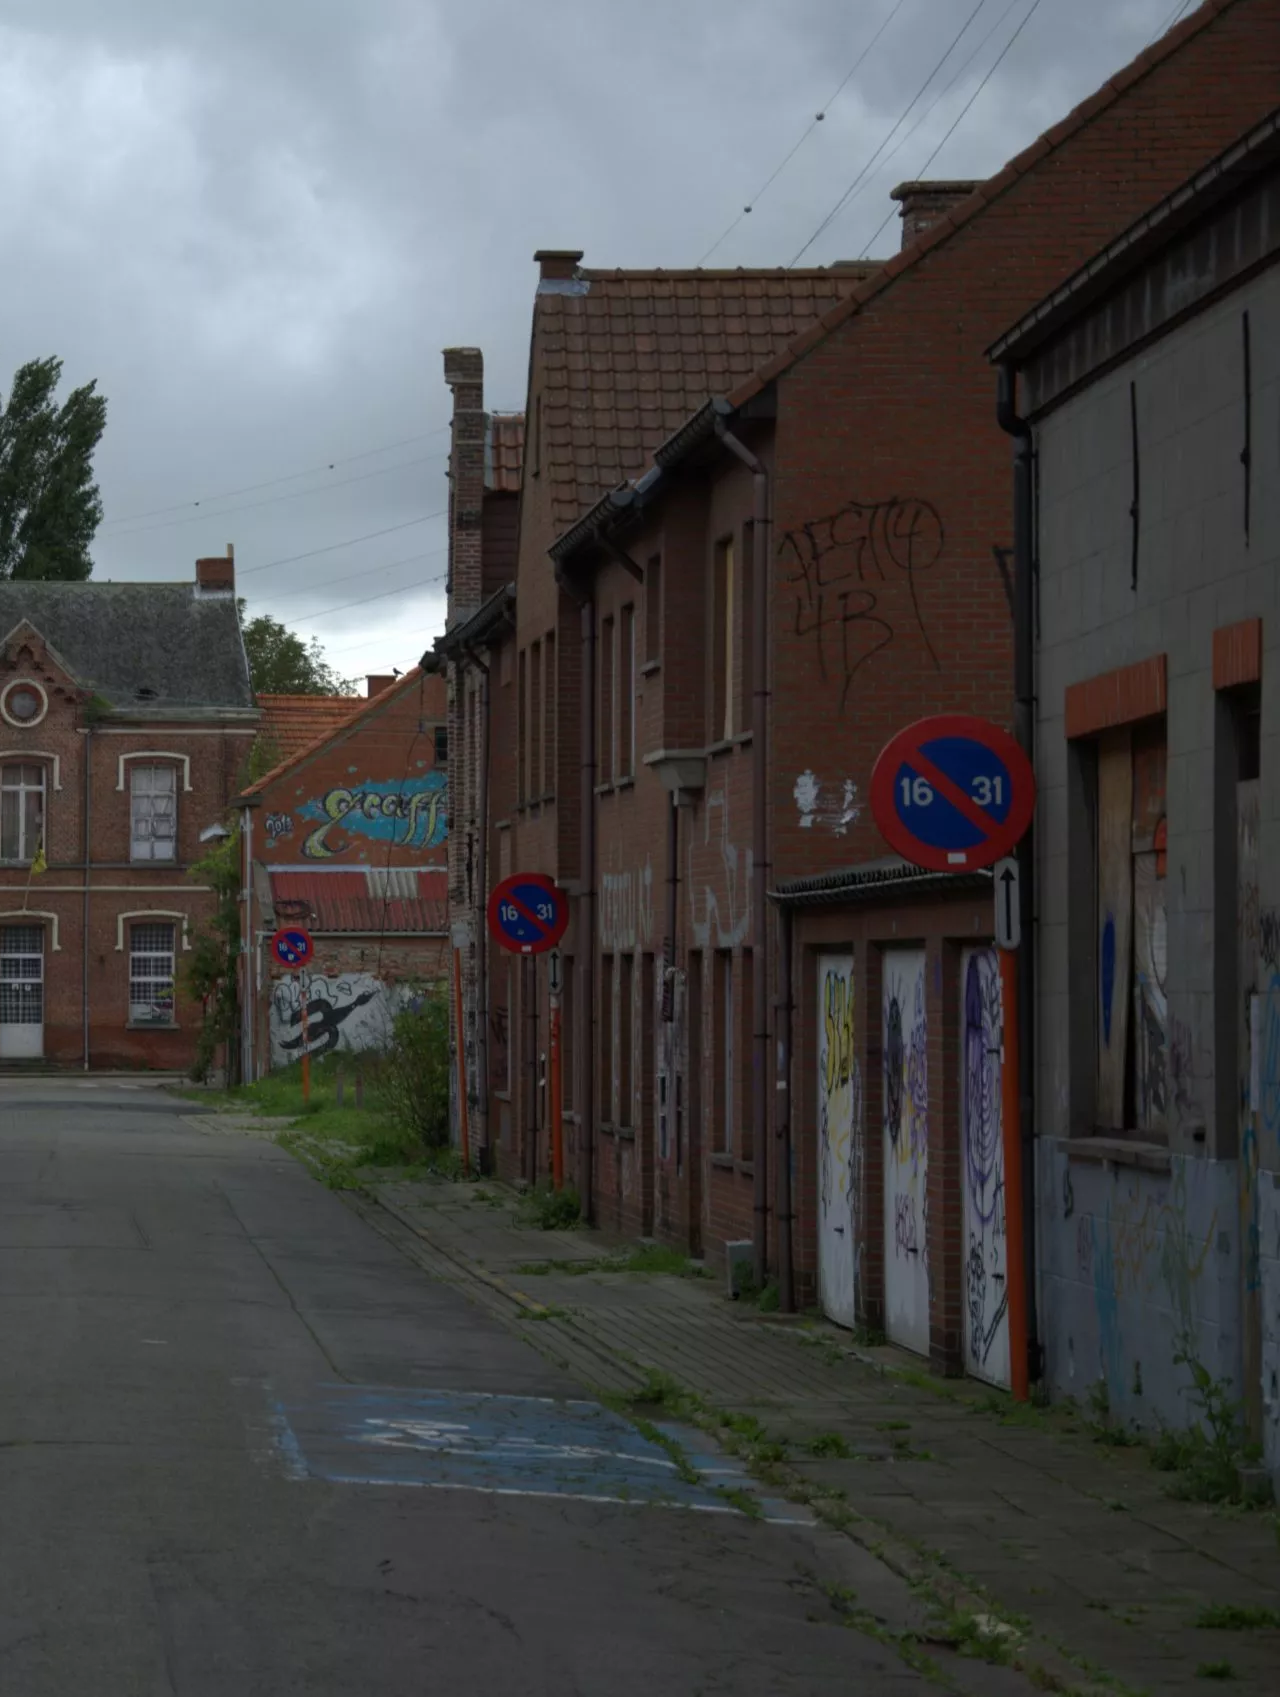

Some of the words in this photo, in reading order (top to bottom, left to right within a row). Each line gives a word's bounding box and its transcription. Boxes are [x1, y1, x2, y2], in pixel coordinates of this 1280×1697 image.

[899, 776, 934, 808] 16
[971, 775, 1003, 806] 31
[500, 903, 520, 923] 16
[535, 902, 553, 921] 31
